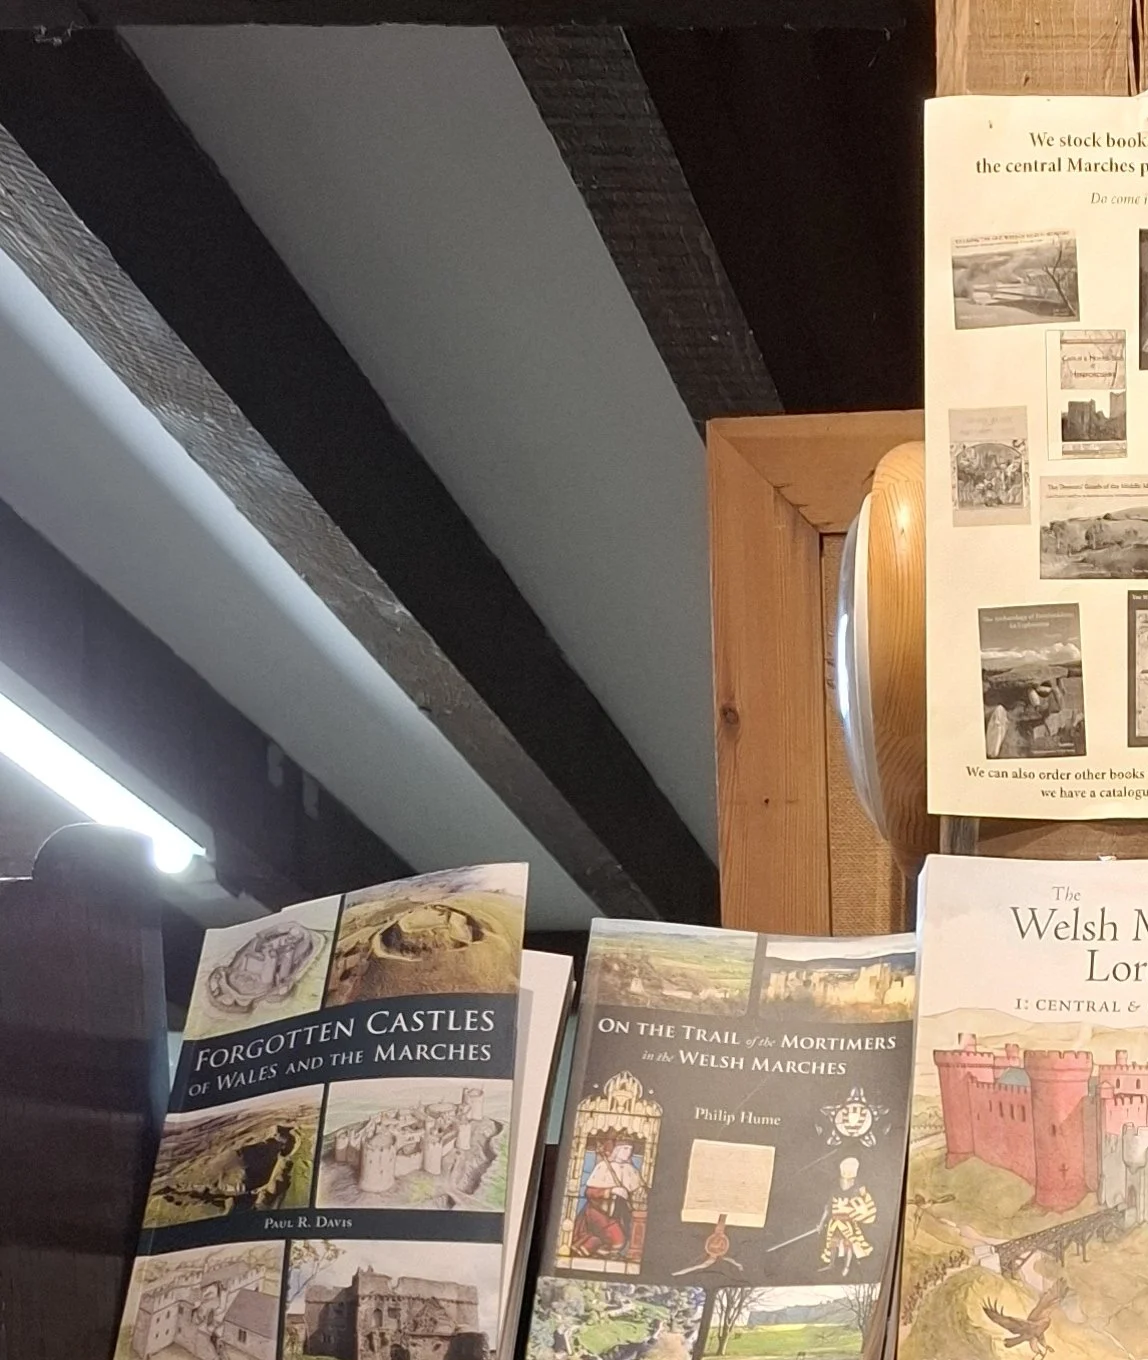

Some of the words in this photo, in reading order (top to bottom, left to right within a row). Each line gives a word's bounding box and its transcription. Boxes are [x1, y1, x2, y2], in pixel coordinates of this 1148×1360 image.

[1029, 132, 1055, 148] We
[1059, 132, 1101, 149] stock
[976, 157, 1001, 175] the
[1005, 157, 1062, 174] central
[1067, 157, 1135, 174] Marches
[1051, 885, 1081, 902] The
[1011, 906, 1119, 942] Welsh
[745, 1035, 759, 1049] of
[758, 1035, 776, 1049] the
